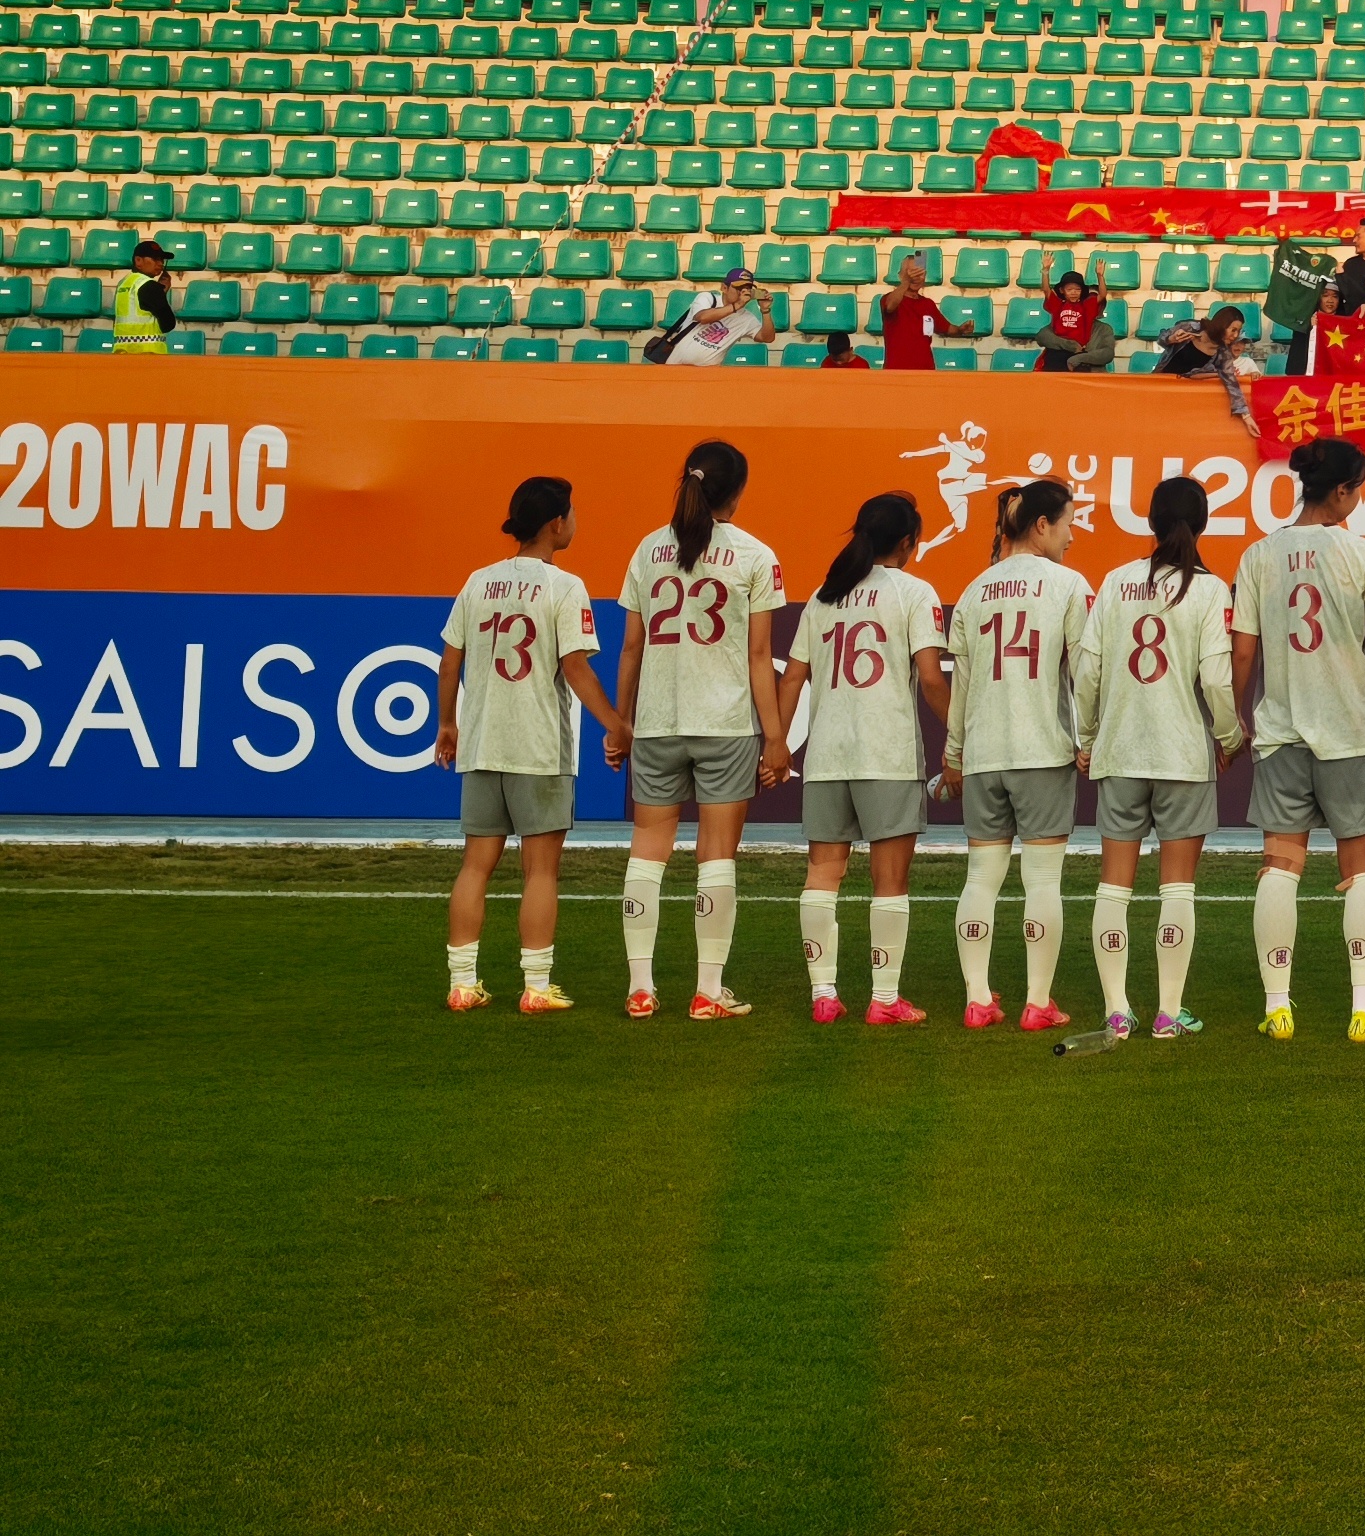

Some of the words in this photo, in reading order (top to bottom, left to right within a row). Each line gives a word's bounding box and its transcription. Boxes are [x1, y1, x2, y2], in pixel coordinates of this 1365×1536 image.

[0, 422, 288, 530] 20WAC
[1067, 453, 1098, 533] AFC
[651, 544, 677, 564] CHE
[1305, 550, 1316, 570] K
[484, 580, 513, 600] XIAO
[517, 581, 530, 600] Y
[530, 584, 542, 603] F
[649, 576, 728, 646] 23
[854, 588, 864, 606] Y
[867, 589, 878, 607] H
[980, 579, 1028, 602] ZHANG
[1032, 579, 1043, 597] J
[1163, 582, 1175, 602] Y
[1288, 582, 1324, 653] 3
[479, 611, 537, 683] 13
[821, 620, 887, 690] 16
[979, 610, 1041, 682] 14
[1128, 613, 1169, 685] 8
[0, 637, 460, 773] SAISO
